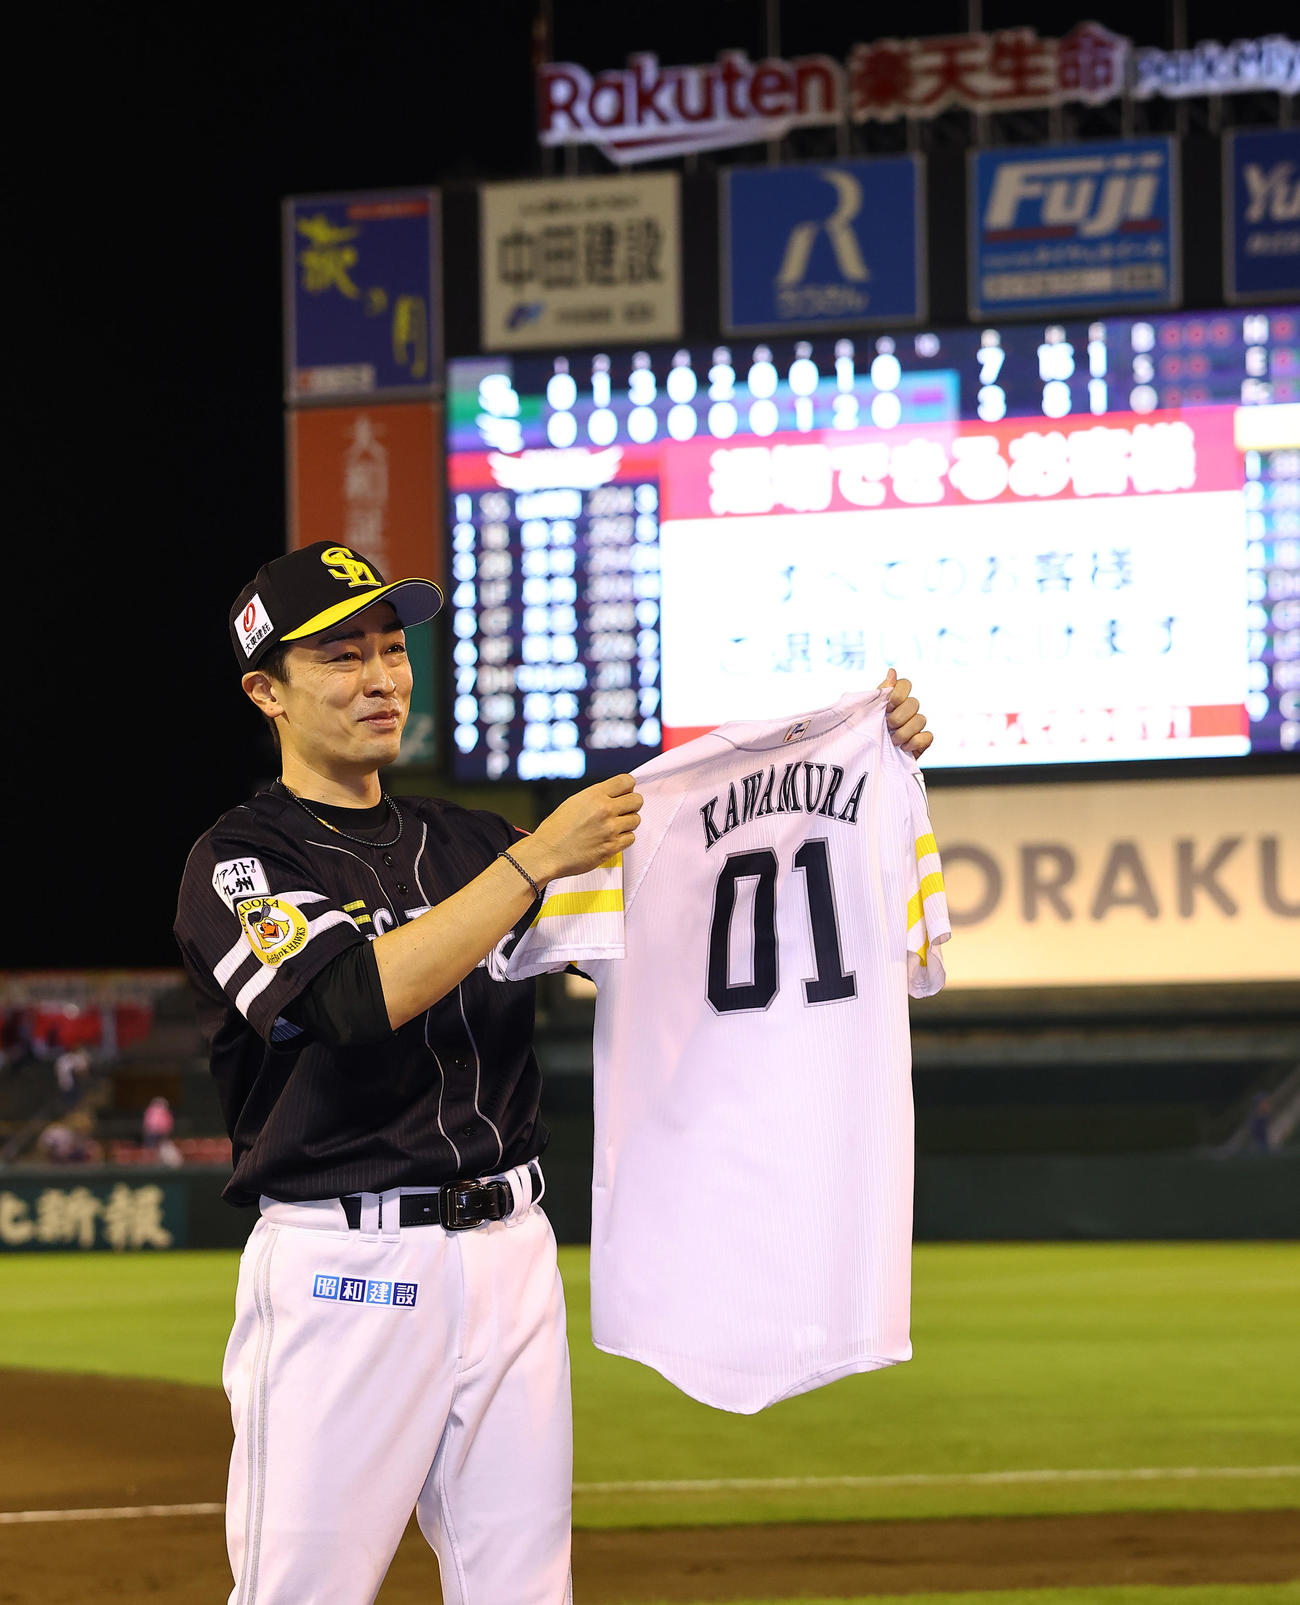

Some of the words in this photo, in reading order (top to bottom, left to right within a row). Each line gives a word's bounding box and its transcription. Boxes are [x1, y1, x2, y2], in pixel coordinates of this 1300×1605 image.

[540, 54, 844, 136] Rakuten
[983, 152, 1164, 238] Fuji
[245, 622, 270, 655] 大東建託
[699, 761, 869, 852] KAWAMURA
[223, 876, 255, 903] 九州
[288, 926, 306, 951] HAWKS
[704, 837, 858, 1016] 01
[314, 1275, 416, 1306] 昭和建設
